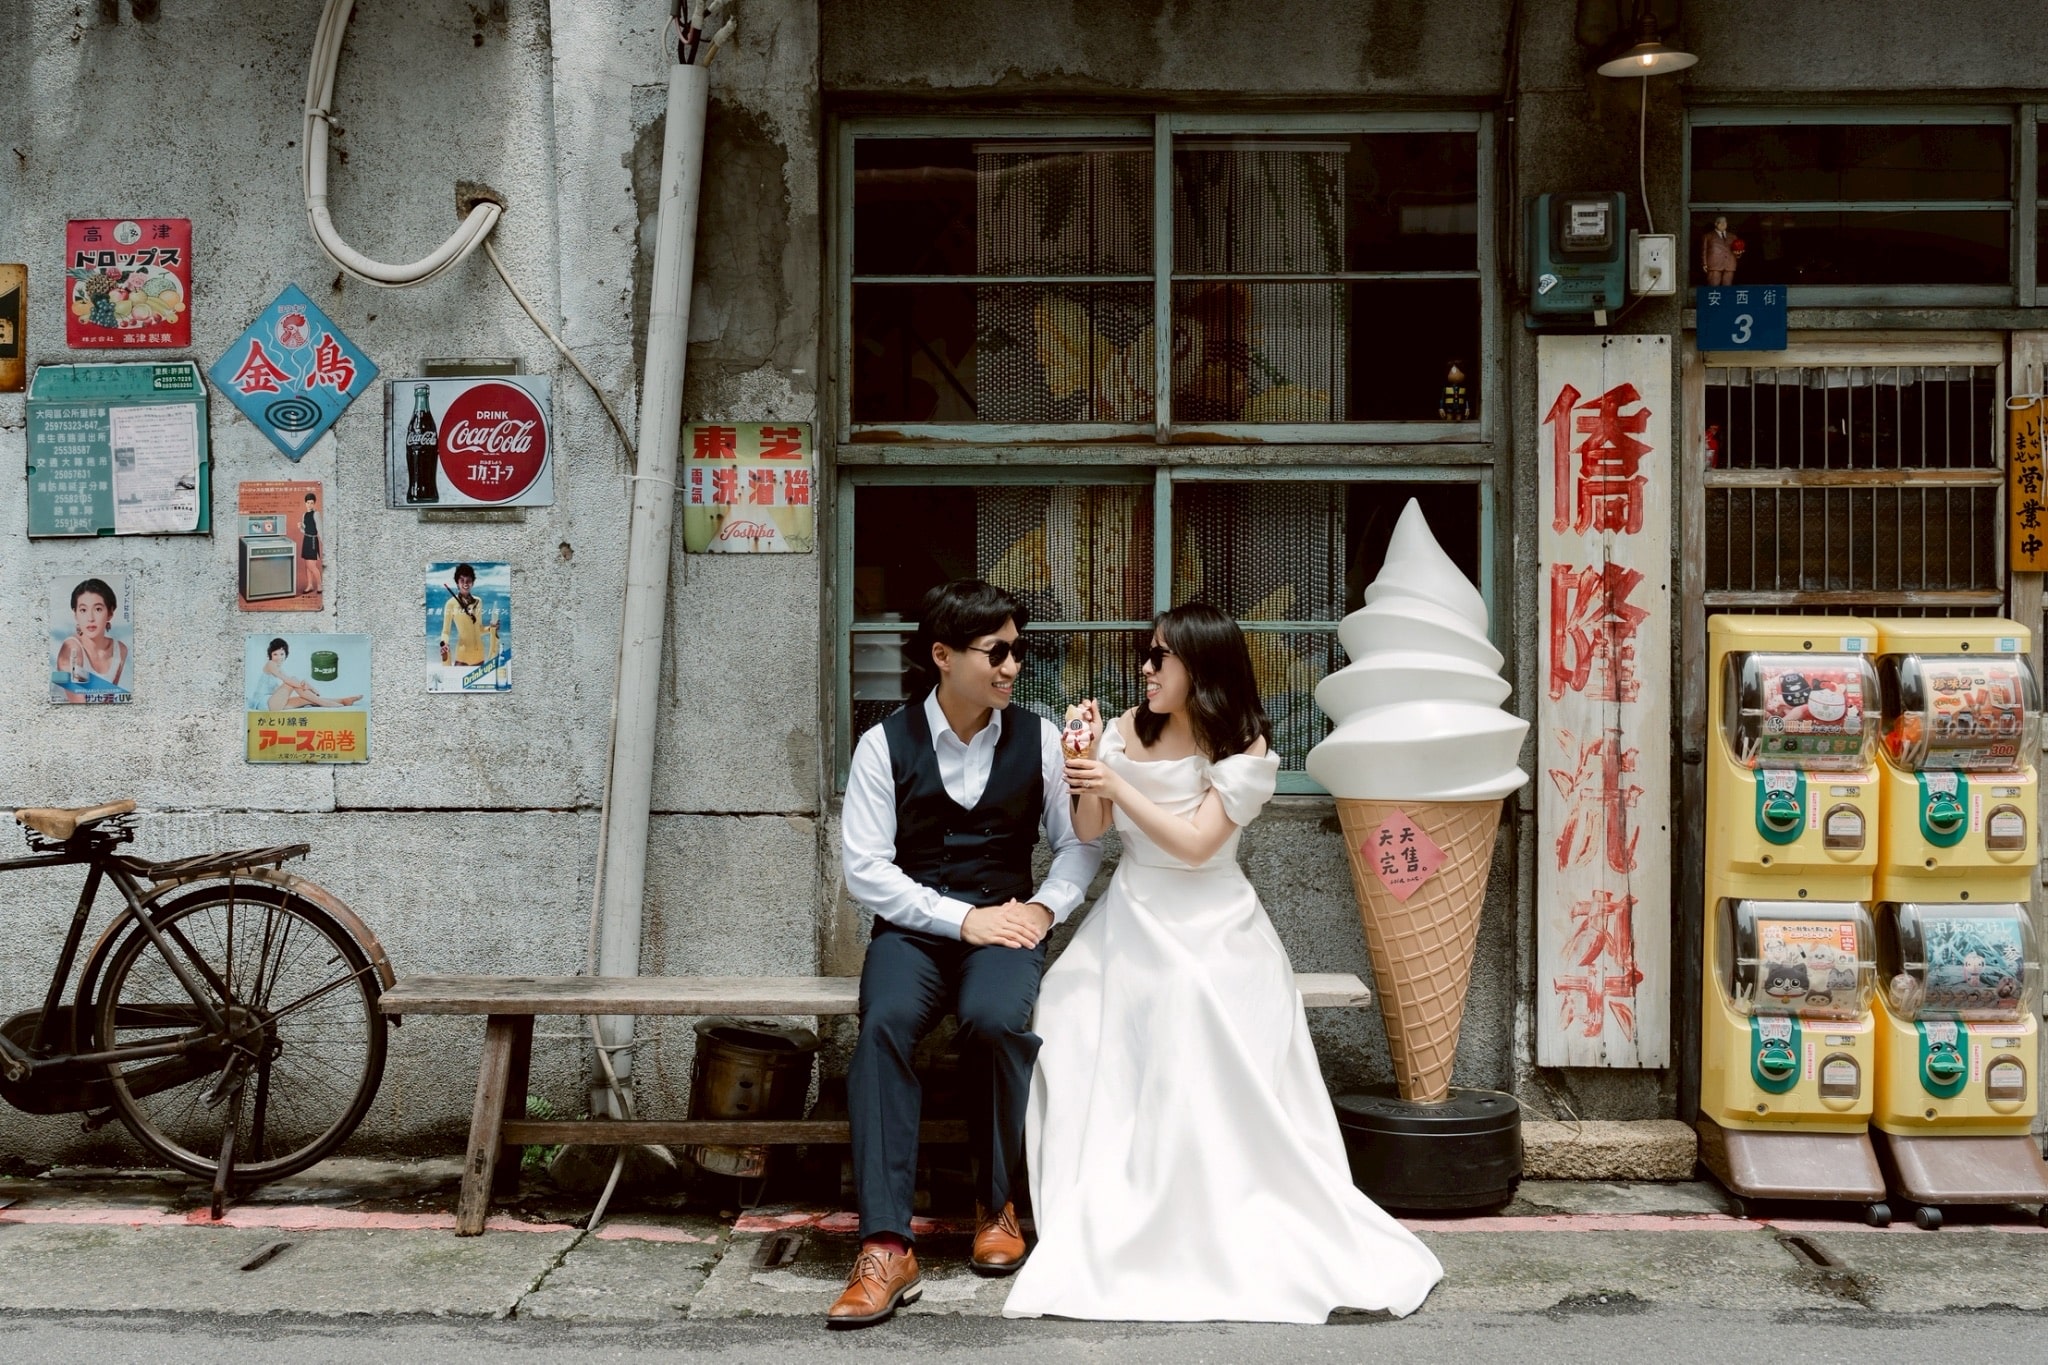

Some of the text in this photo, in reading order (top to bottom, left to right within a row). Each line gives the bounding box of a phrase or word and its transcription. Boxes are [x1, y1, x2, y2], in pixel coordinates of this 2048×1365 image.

[75, 247, 181, 268] ドロップス
[1707, 290, 1777, 307] 安西街
[123, 333, 173, 343] 高津製菓
[1731, 313, 1754, 344] 3
[229, 332, 356, 395] 金鳥
[476, 411, 509, 420] DRINK
[446, 419, 537, 454] Coca-Cola
[693, 425, 803, 460] 東芝
[53, 445, 91, 456] 25538587
[720, 520, 775, 541] Toshiba
[463, 659, 497, 686] Drink up!
[257, 717, 309, 727] かとり線香
[258, 730, 356, 752] アース渦巻
[1991, 745, 2014, 756] 300
